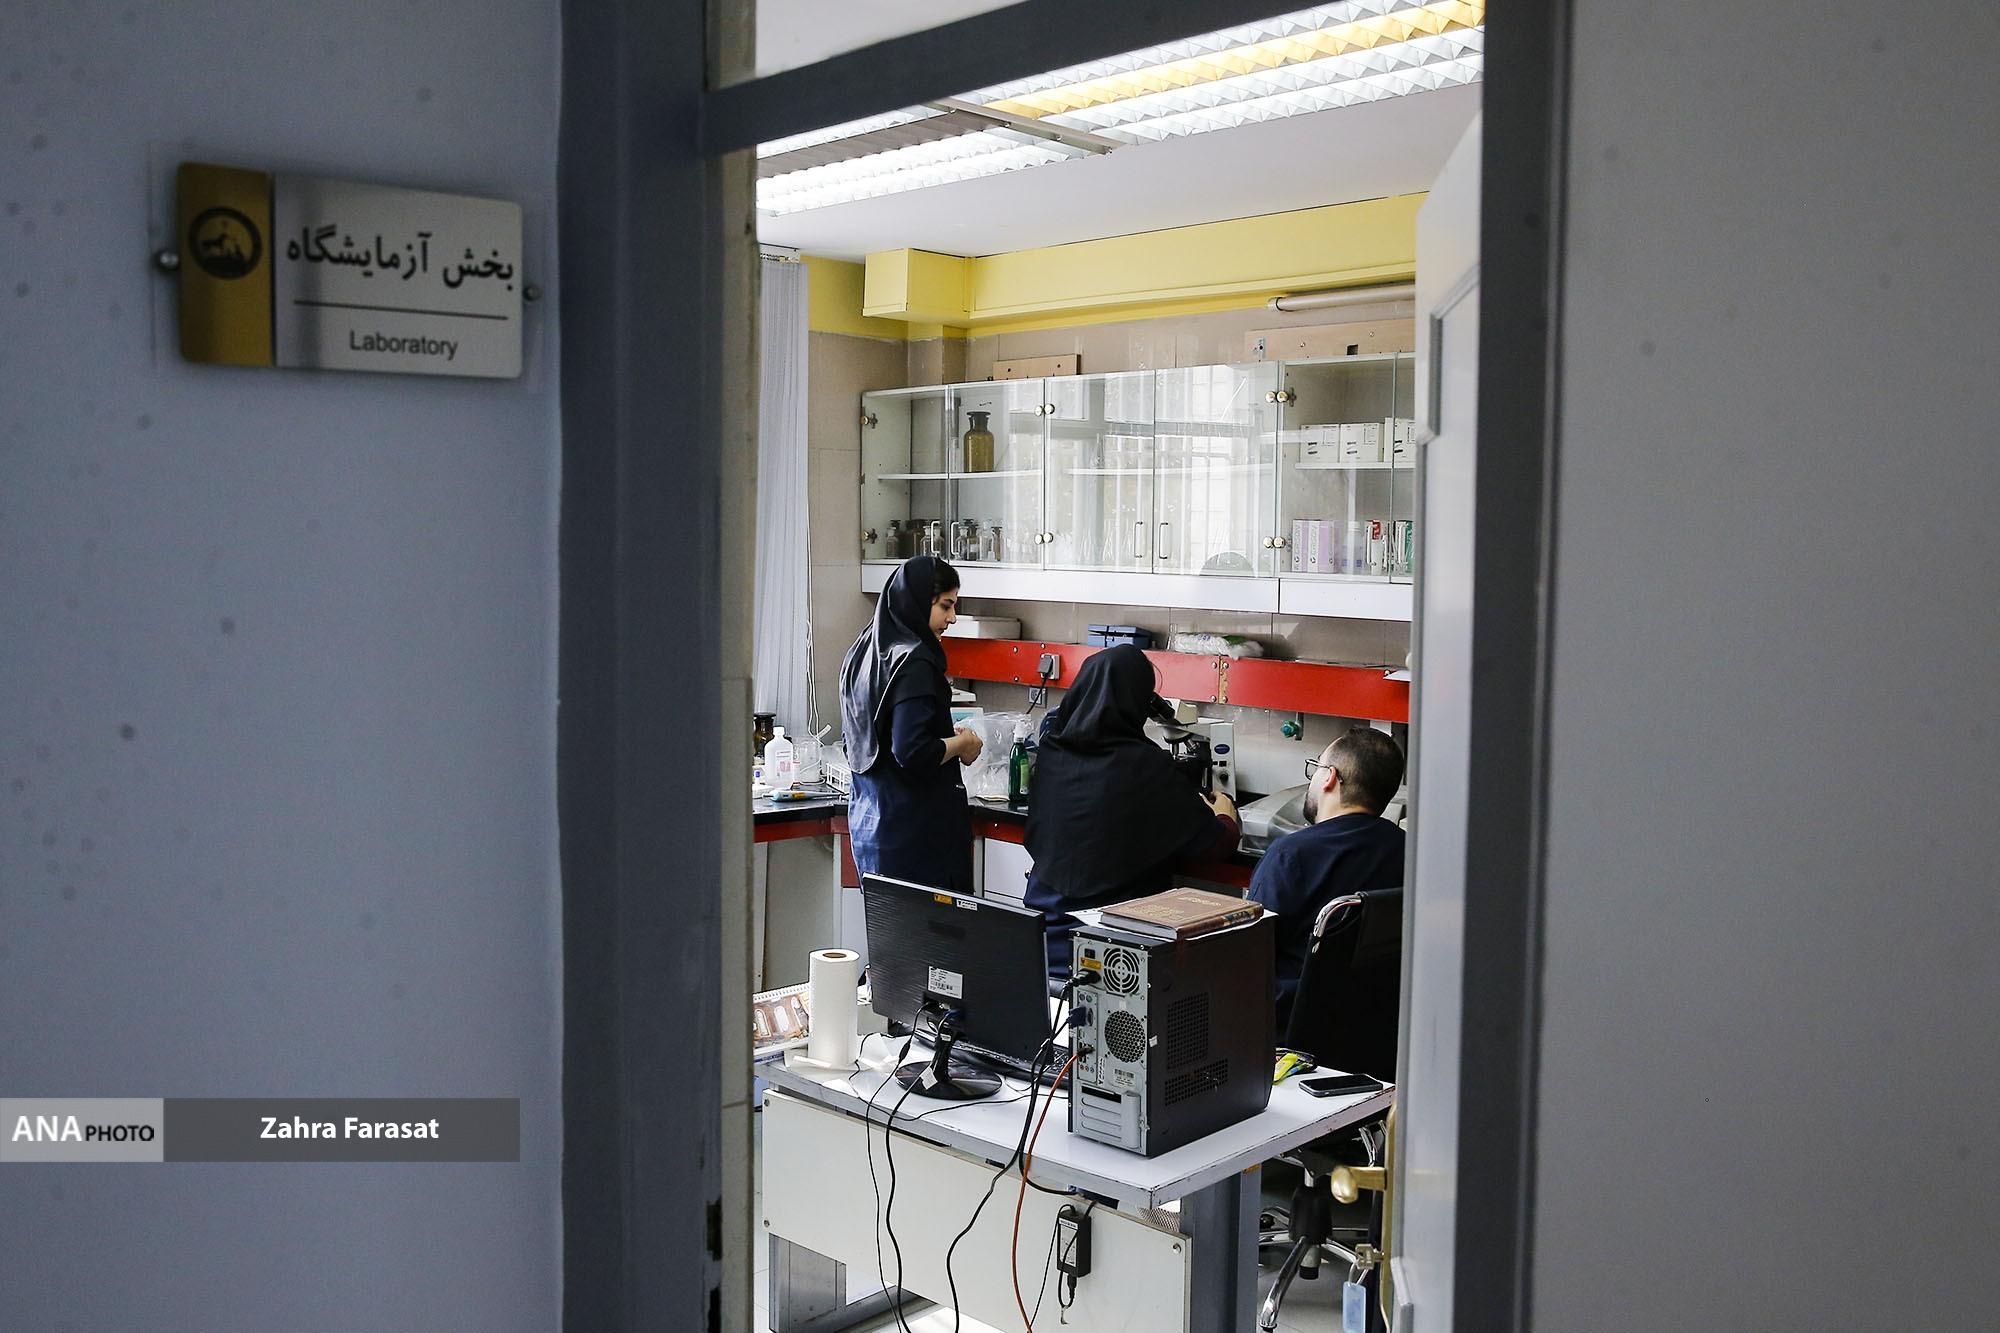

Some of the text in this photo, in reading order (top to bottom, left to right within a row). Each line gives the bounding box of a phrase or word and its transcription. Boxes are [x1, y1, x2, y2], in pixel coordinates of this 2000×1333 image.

[287, 224, 514, 291] بخش آزمایشگاه
[350, 330, 459, 361] Laboratory
